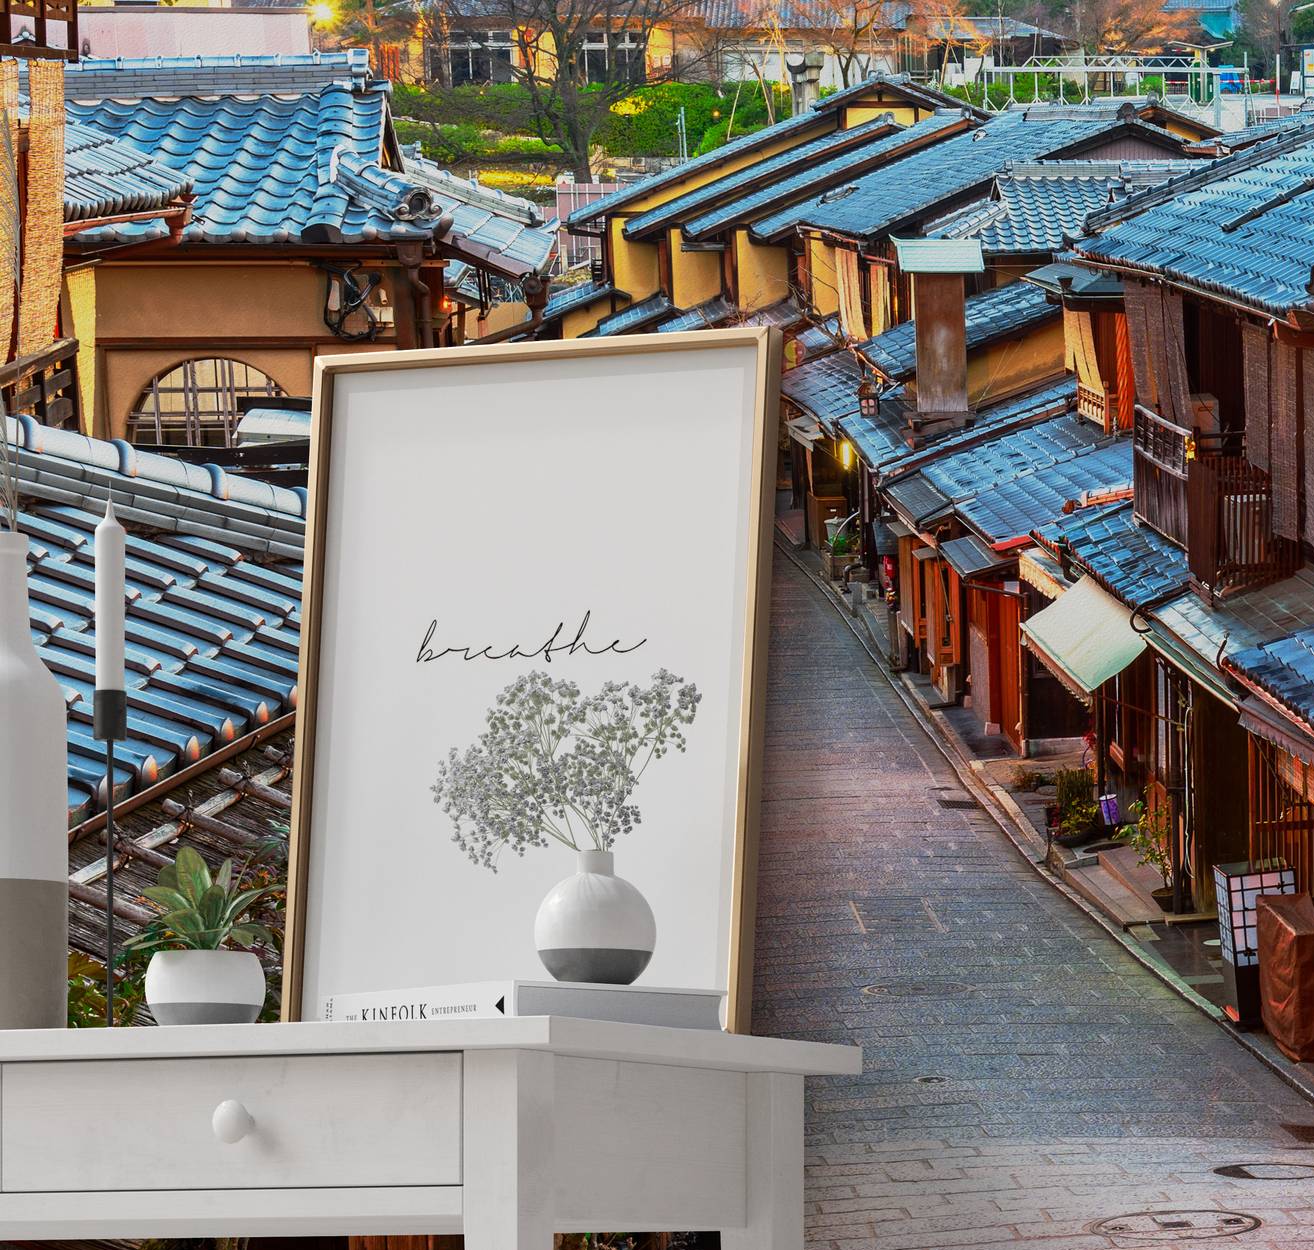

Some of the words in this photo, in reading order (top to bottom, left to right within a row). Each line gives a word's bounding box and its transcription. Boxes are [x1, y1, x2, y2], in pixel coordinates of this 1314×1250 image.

[416, 609, 647, 662] breathe
[361, 1003, 427, 1021] KINFOLK
[431, 1003, 477, 1016] ENTREPRENEUR
